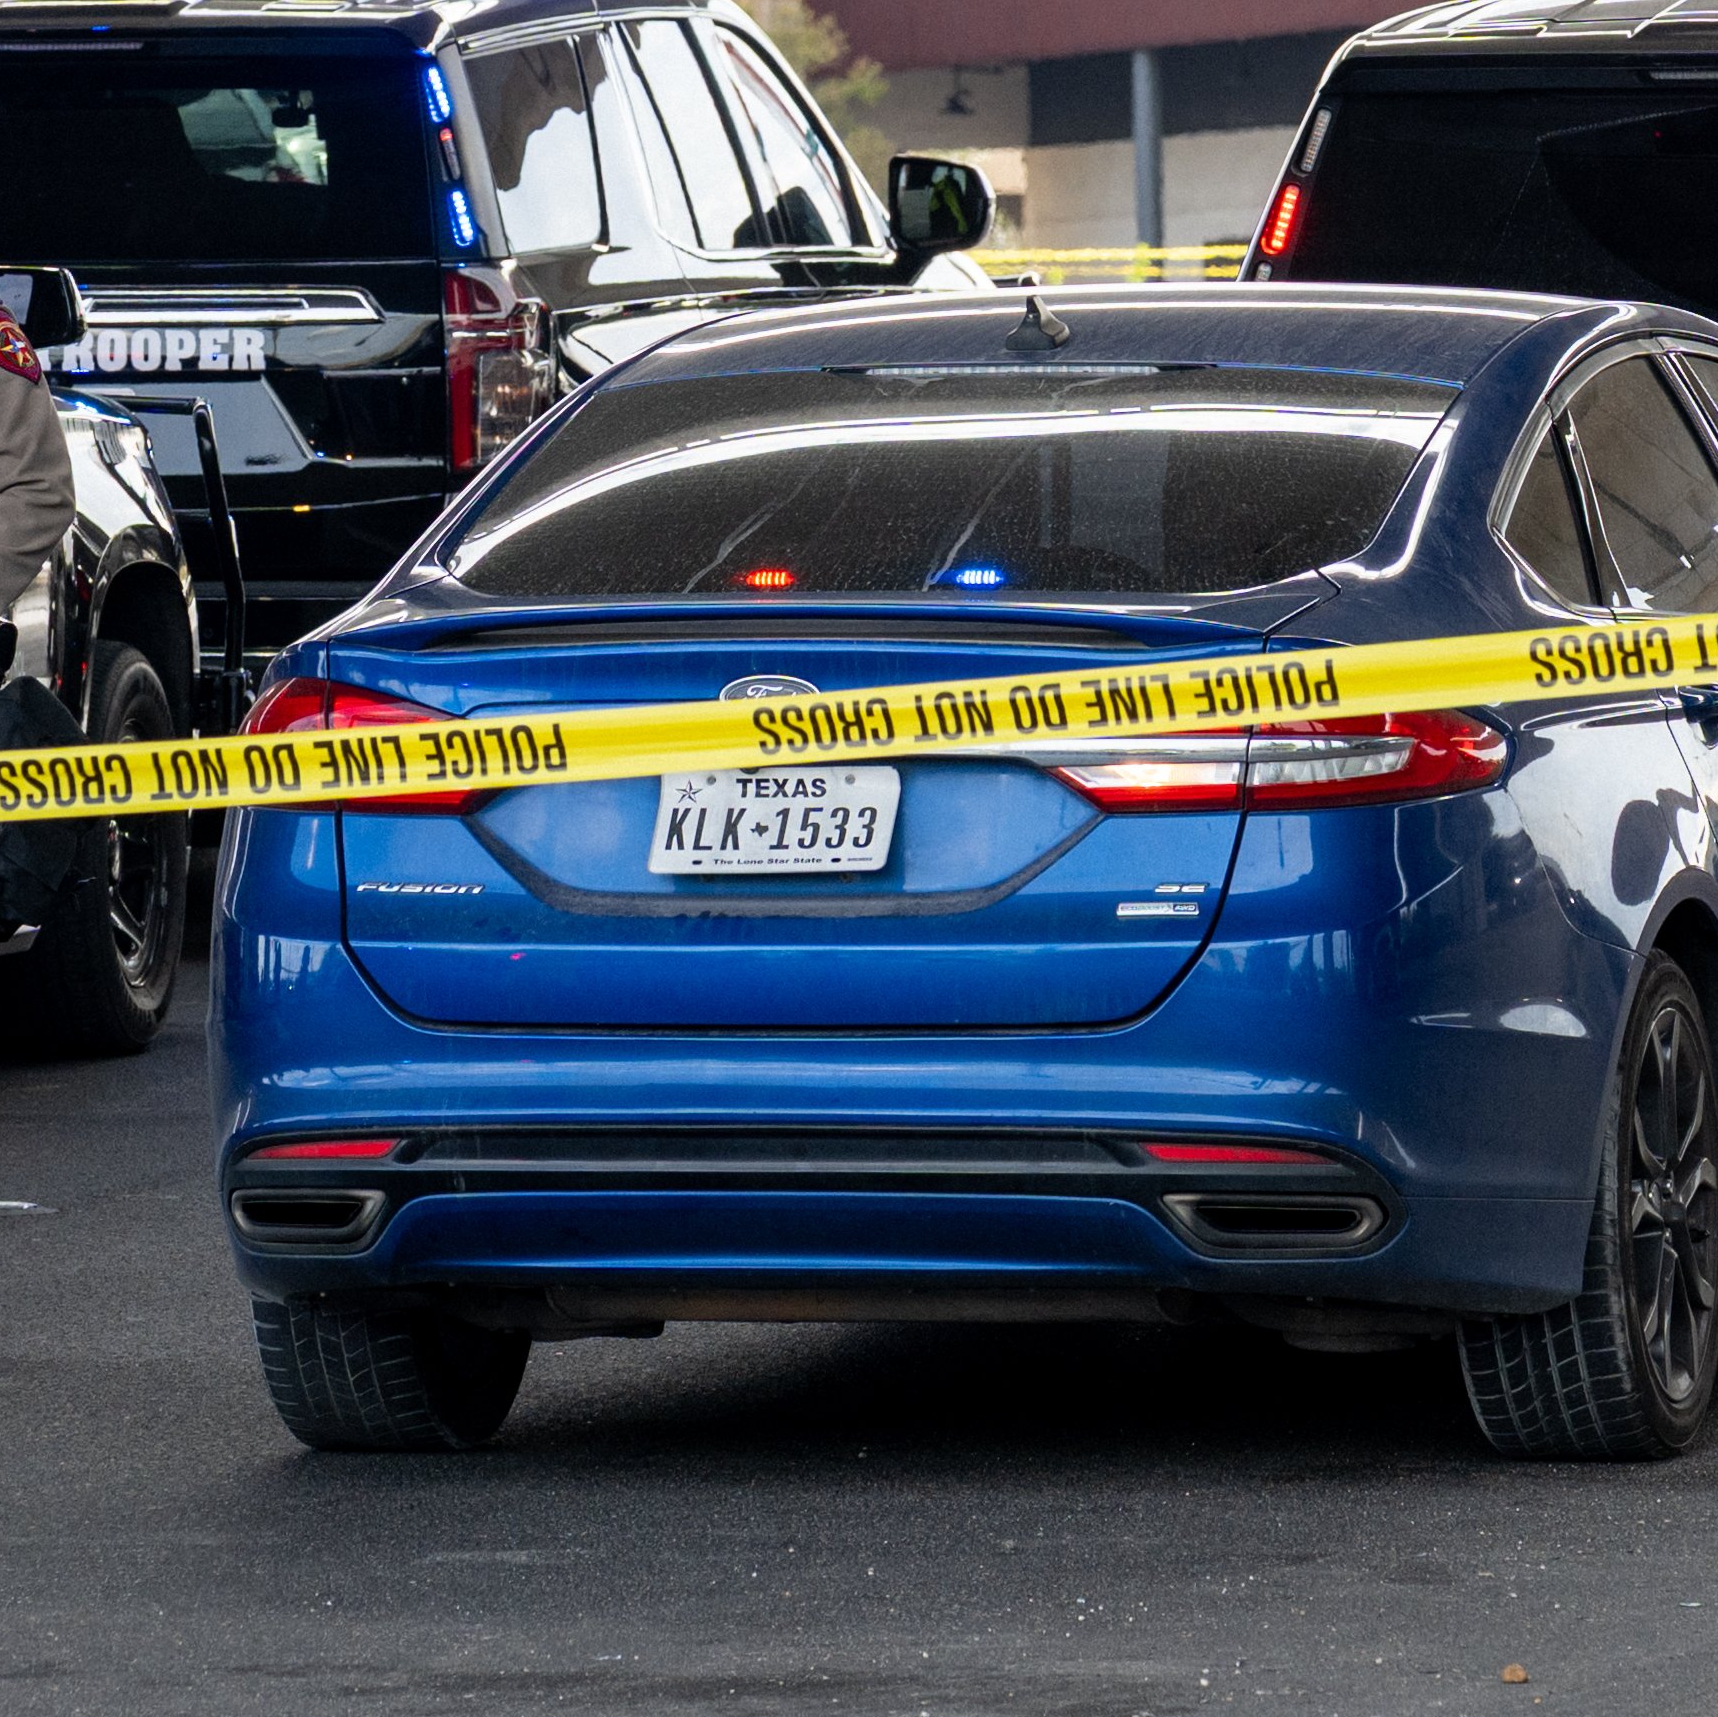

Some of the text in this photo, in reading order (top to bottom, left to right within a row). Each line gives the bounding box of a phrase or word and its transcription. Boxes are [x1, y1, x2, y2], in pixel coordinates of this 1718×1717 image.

[1528, 626, 1674, 688] CROSS
[752, 658, 1340, 755] POLICE LINE DO NOT CROSS
[150, 748, 230, 801] NOT
[244, 742, 302, 794] DO
[313, 735, 408, 789] LINE
[419, 723, 568, 781] POLICE
[736, 778, 827, 799] TEXAS
[664, 806, 878, 851] KLK 1533
